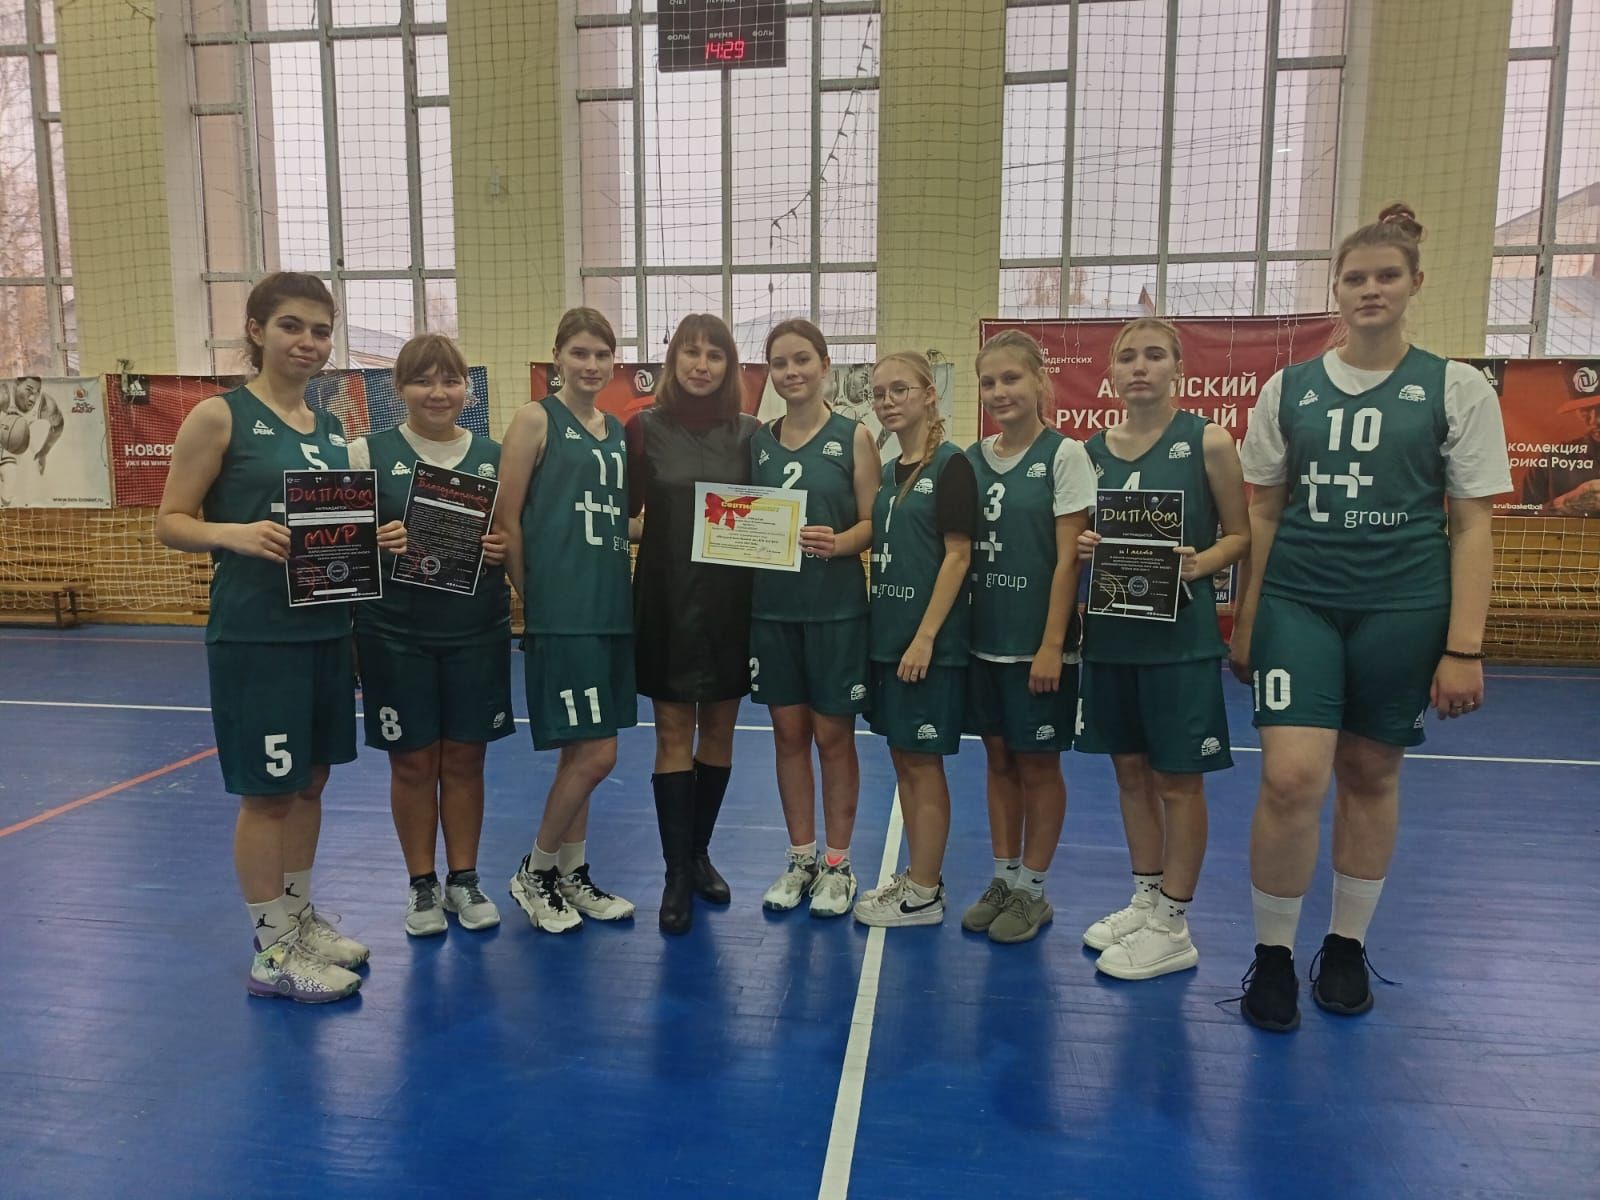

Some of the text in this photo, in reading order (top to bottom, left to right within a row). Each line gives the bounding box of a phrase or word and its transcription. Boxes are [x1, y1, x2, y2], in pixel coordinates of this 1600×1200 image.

[1327, 407, 1383, 451] 10
[301, 443, 328, 470] 5
[1508, 442, 1588, 455] коллекция
[1509, 457, 1594, 471] рика Роуза
[591, 448, 624, 489] 11
[781, 461, 803, 489] 2
[984, 483, 1006, 522] 3
[304, 524, 357, 548] MVP
[985, 573, 1028, 592] group
[748, 657, 760, 691] 2
[1253, 668, 1291, 711] 10
[379, 706, 402, 741] 8
[560, 687, 602, 726] 11
[264, 733, 293, 777] 5
